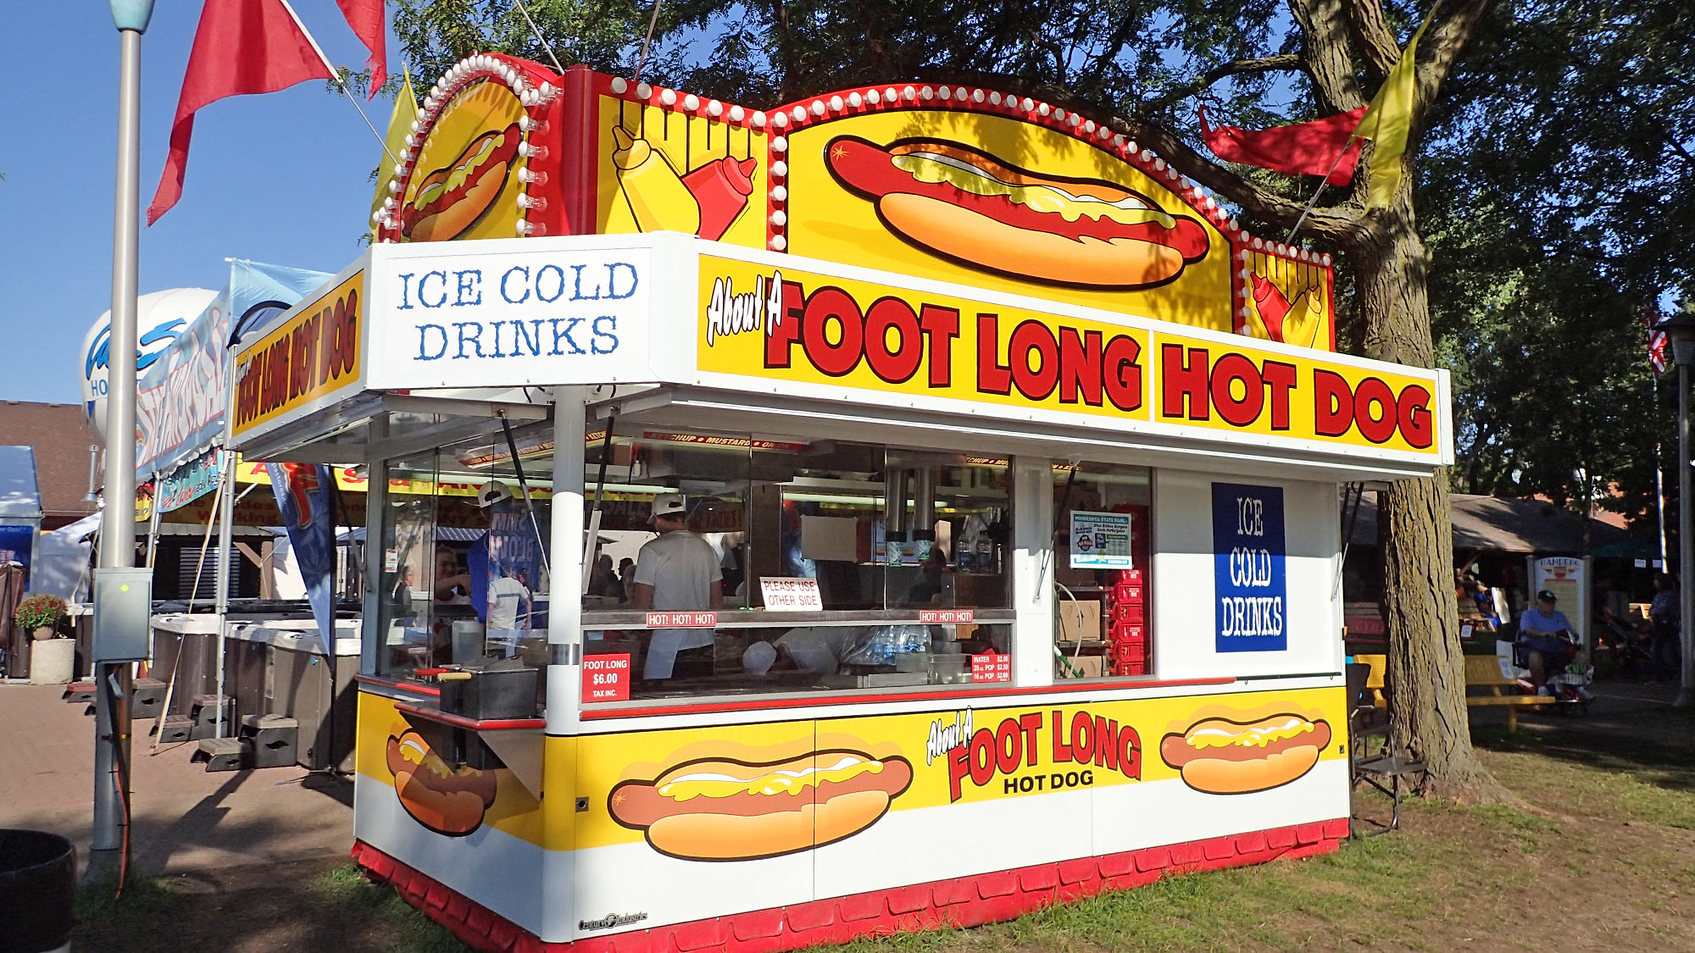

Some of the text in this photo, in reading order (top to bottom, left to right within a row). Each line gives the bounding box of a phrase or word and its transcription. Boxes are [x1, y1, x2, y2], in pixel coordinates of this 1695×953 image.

[397, 262, 639, 309] ICE COLD
[260, 333, 290, 415] LONG
[289, 313, 321, 401] HOT
[319, 288, 358, 386] DOG
[413, 316, 620, 360] DRINKS
[707, 270, 1433, 449] About A FOOT LONG HOT DOG
[1237, 497, 1263, 536] ICE
[764, 580, 815, 592] PLEASE USE
[1230, 547, 1271, 587] COLD
[649, 614, 714, 625] HOT! HOT! HOT!
[768, 595, 818, 606] OTHER SIDE
[922, 612, 972, 622] HOT! HOT! HOT!
[1222, 597, 1282, 637] DRINKS
[584, 660, 628, 670] FOOT LONG
[593, 673, 618, 685] $6.00
[926, 705, 1142, 804] About A FOOT LONG
[1003, 770, 1094, 795] HOT DOG
